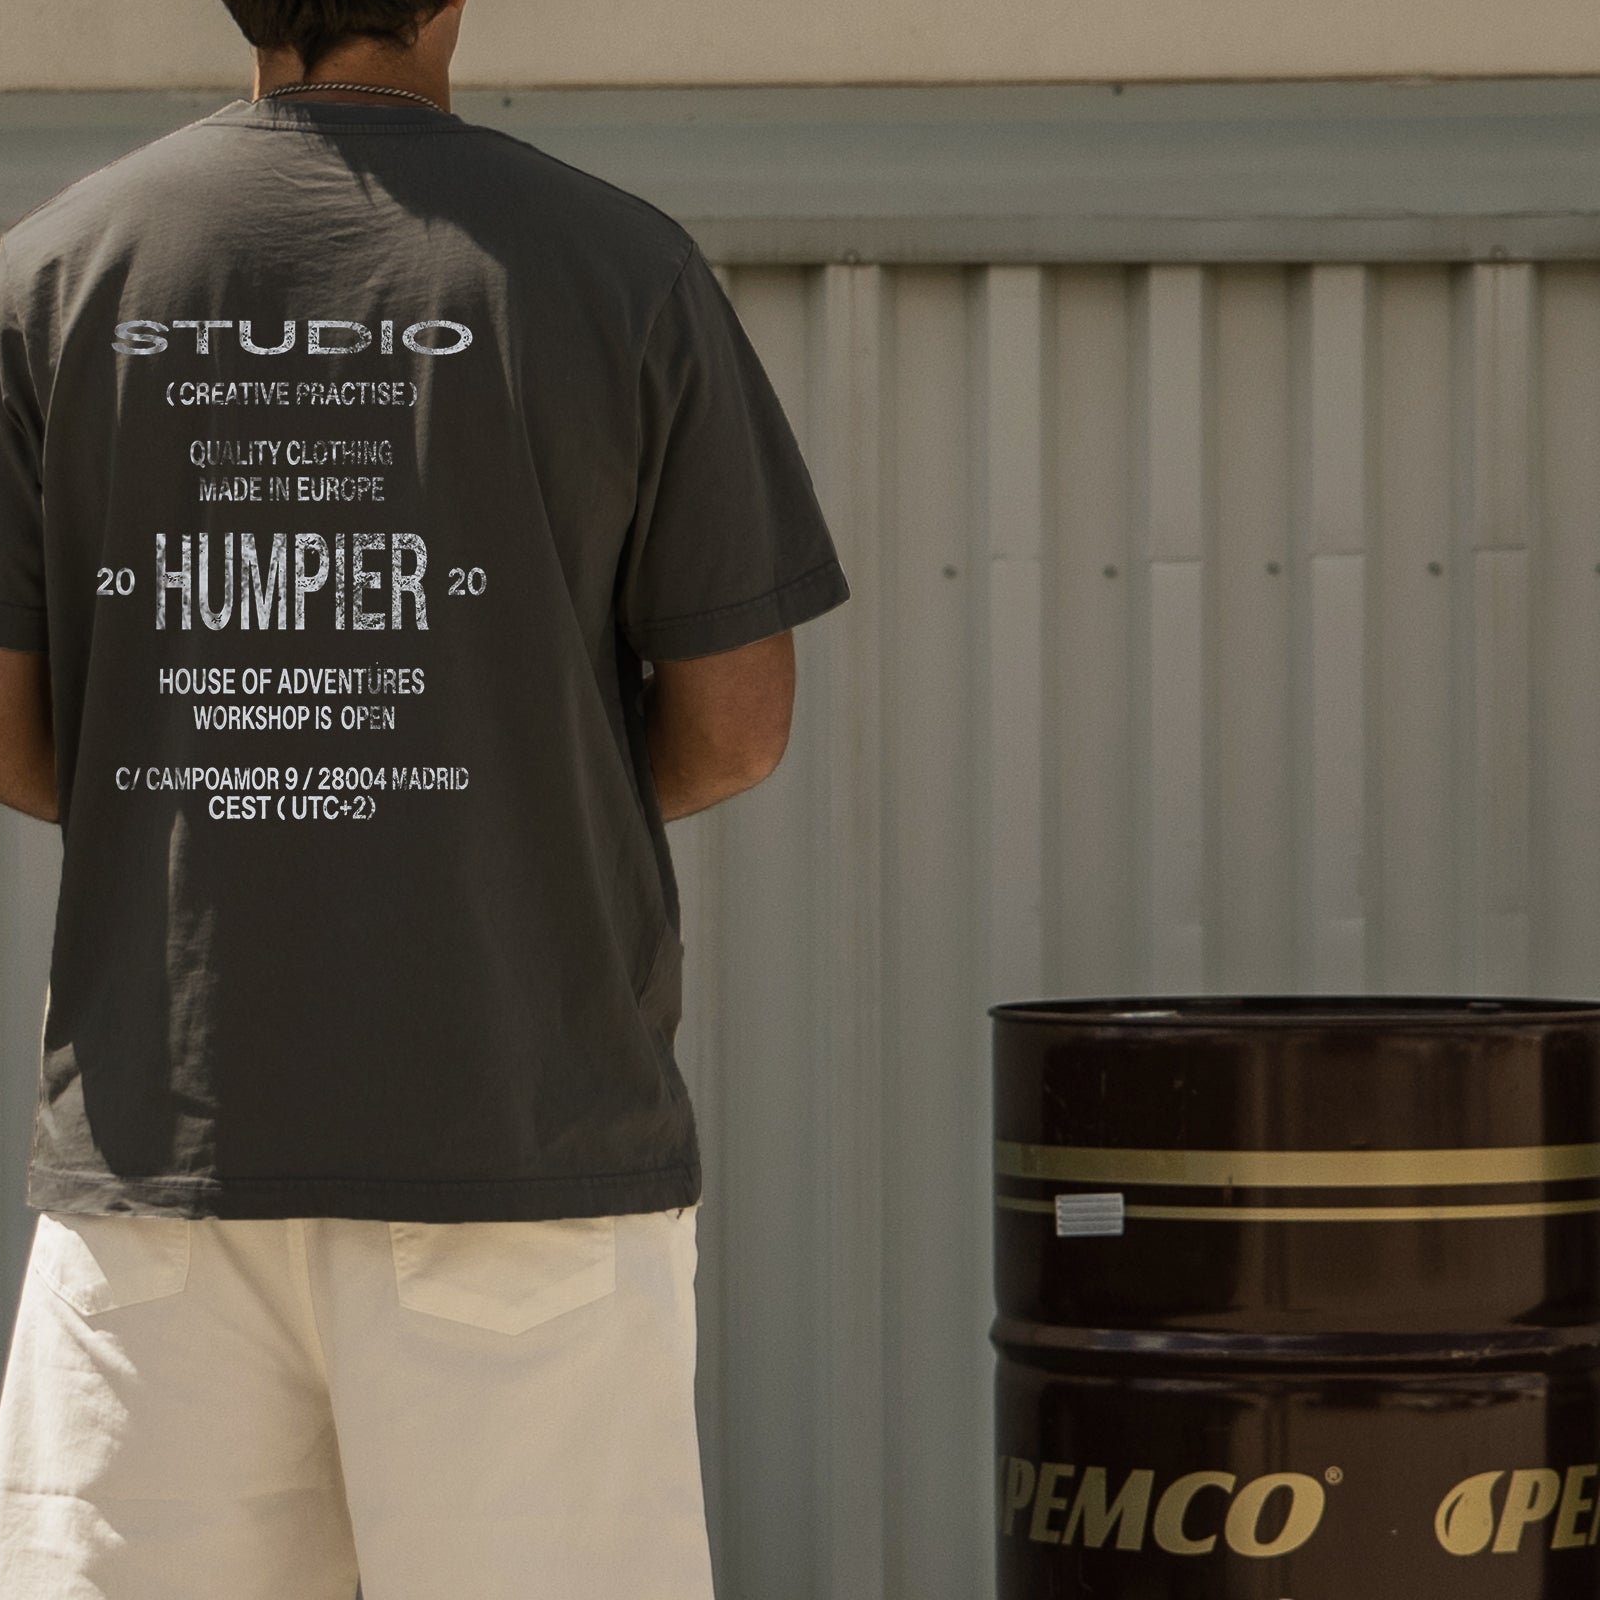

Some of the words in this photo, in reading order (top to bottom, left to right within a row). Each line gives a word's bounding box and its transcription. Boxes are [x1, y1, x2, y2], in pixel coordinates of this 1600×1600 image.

[111, 319, 474, 356] STUDIO
[189, 439, 282, 469] QUALITY
[286, 439, 394, 466] CLOTHING
[199, 476, 263, 502] MADE
[269, 476, 290, 502] IN
[297, 476, 385, 502] EUROPE
[96, 566, 136, 596] 20
[155, 532, 430, 631] HUMPIER
[447, 566, 487, 596] 20
[159, 667, 236, 695] HOUSE
[241, 667, 273, 695] OF
[276, 667, 425, 695] ADVENTURES
[192, 705, 311, 731] WORKSHOP
[315, 705, 333, 731] IS
[340, 705, 396, 731] OPEN
[115, 766, 141, 791] C/
[146, 766, 280, 791] CAMPOAMOR
[284, 766, 299, 791] 9
[317, 766, 388, 791] 28004
[391, 766, 470, 791] MADRID
[208, 795, 272, 820] CEST
[1491, 1463, 1600, 1554] PE
